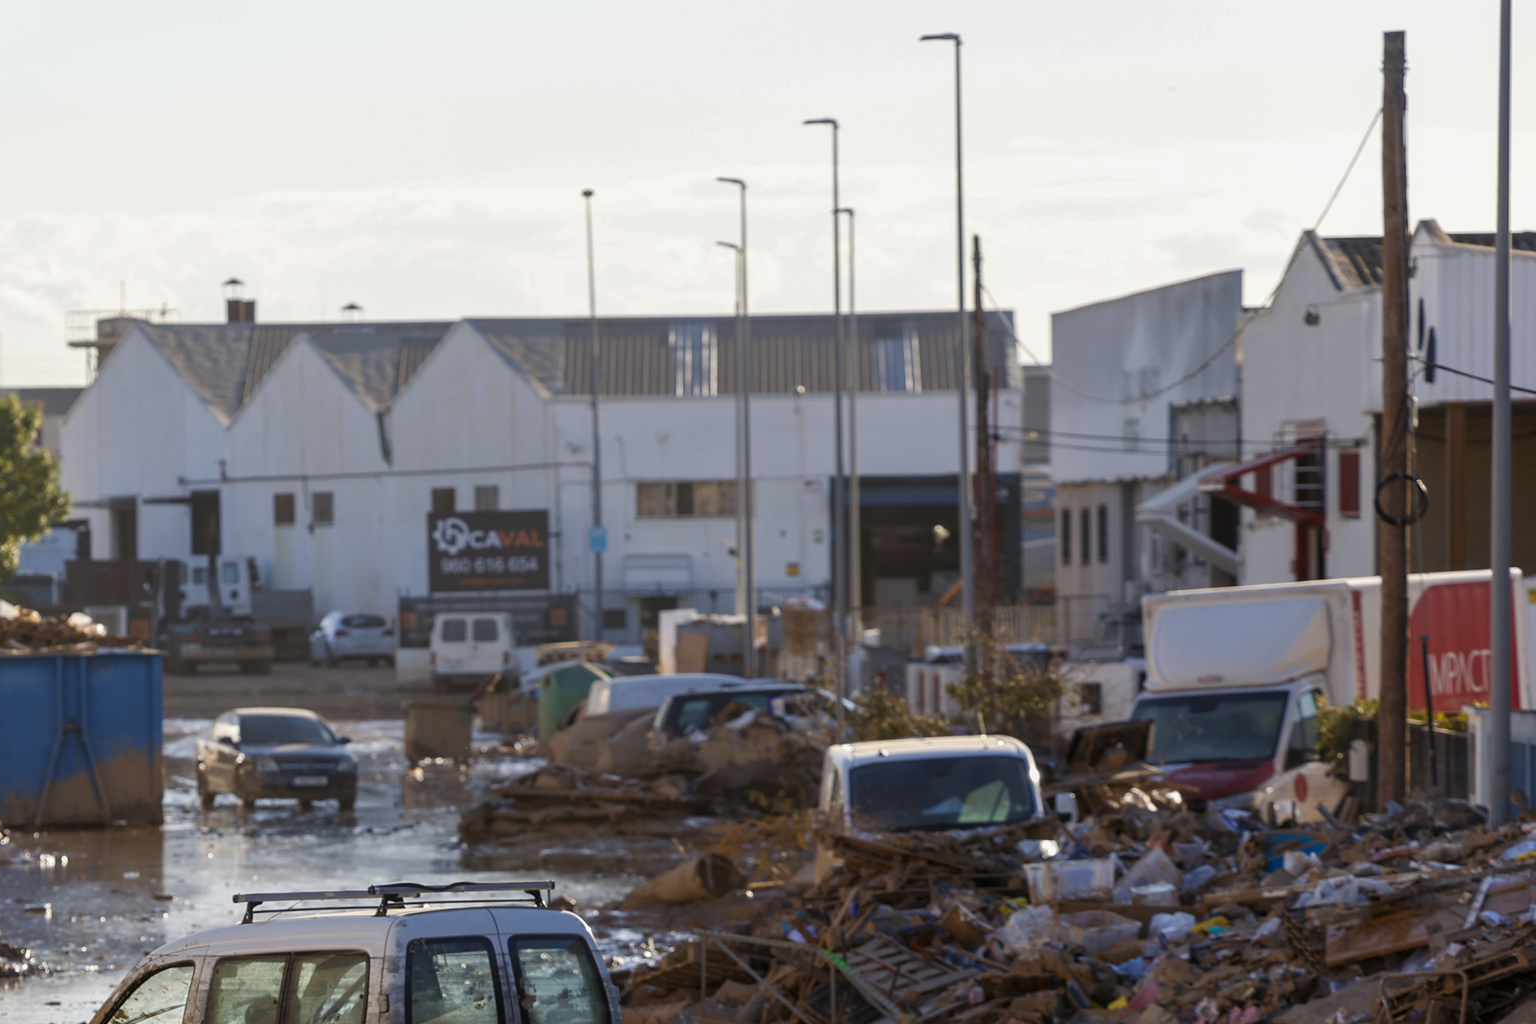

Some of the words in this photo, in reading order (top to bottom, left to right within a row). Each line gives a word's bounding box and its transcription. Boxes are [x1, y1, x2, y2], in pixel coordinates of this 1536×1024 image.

[440, 556, 472, 574] 960
[474, 556, 505, 574] 616
[507, 555, 539, 573] 654
